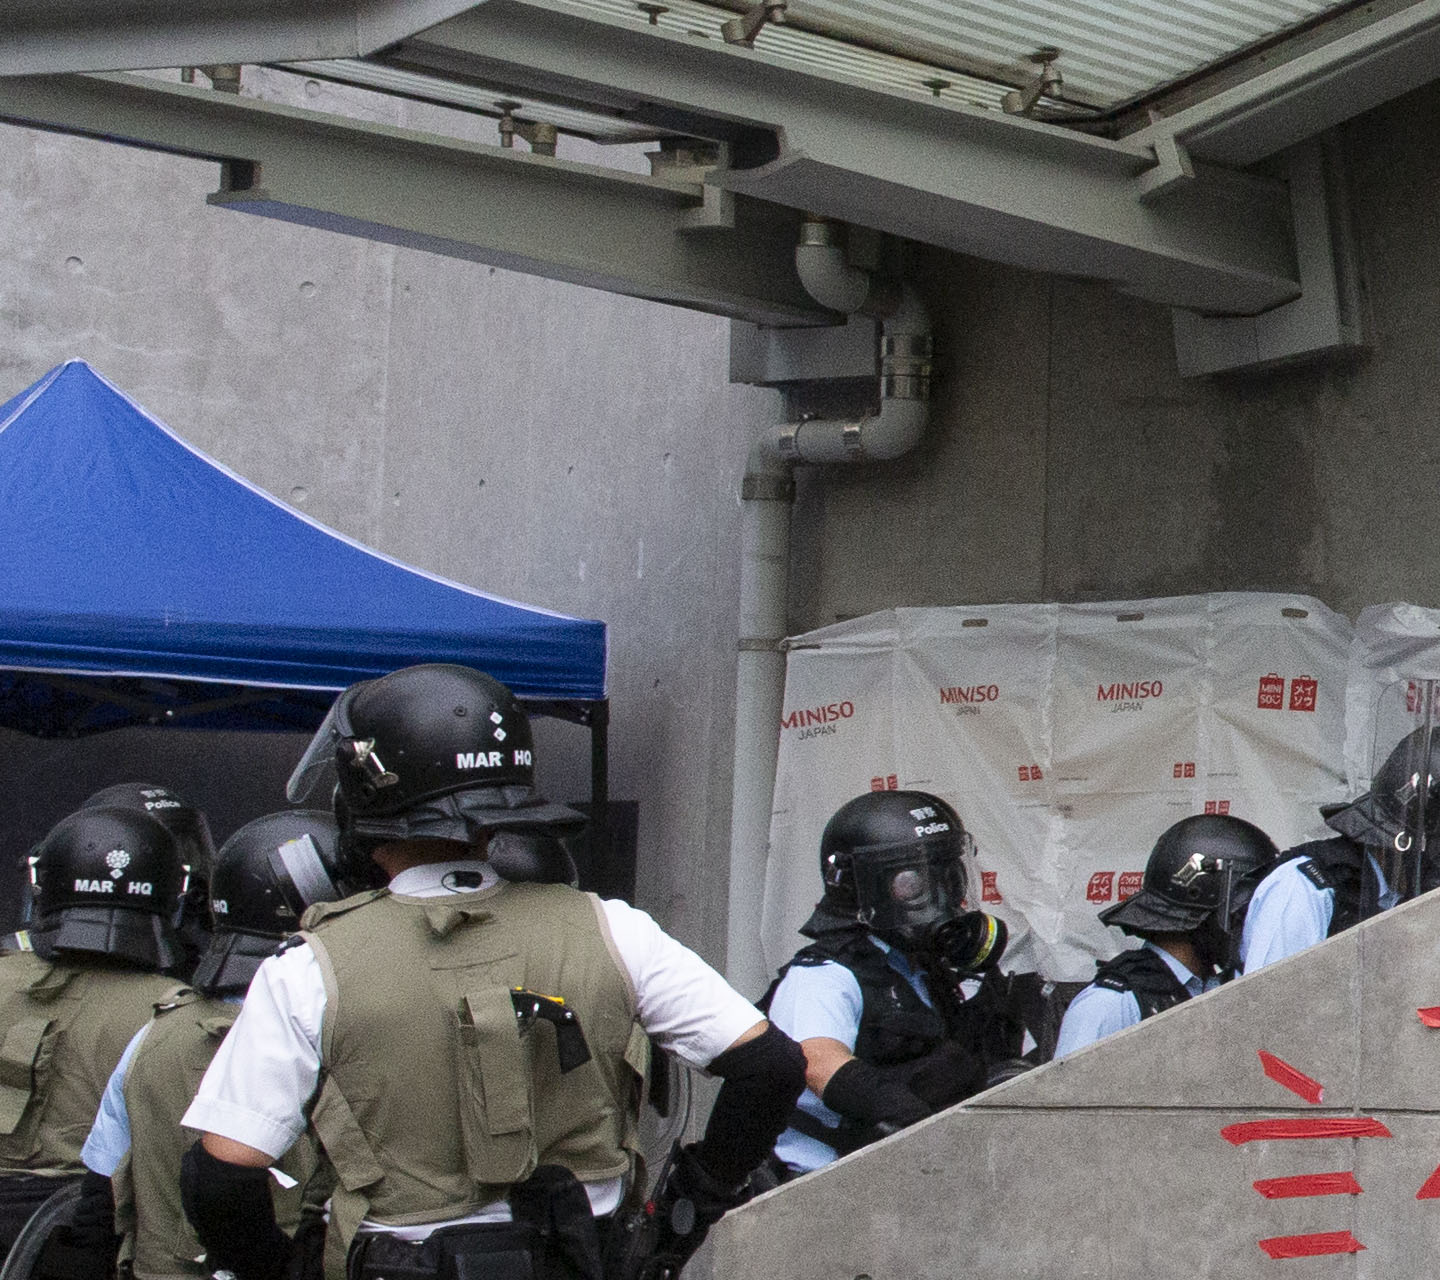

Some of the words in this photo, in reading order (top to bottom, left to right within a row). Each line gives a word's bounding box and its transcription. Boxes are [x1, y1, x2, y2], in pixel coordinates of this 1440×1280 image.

[940, 684, 1000, 705] MINISO
[1097, 680, 1164, 702] MINISO
[779, 700, 855, 730] MINISO
[798, 724, 837, 741] JAPAN
[455, 751, 503, 769] MAR
[513, 749, 532, 766] HQ
[144, 800, 181, 811] Police
[914, 822, 950, 838] Police
[73, 877, 114, 894] MAR
[127, 881, 153, 896] HQ
